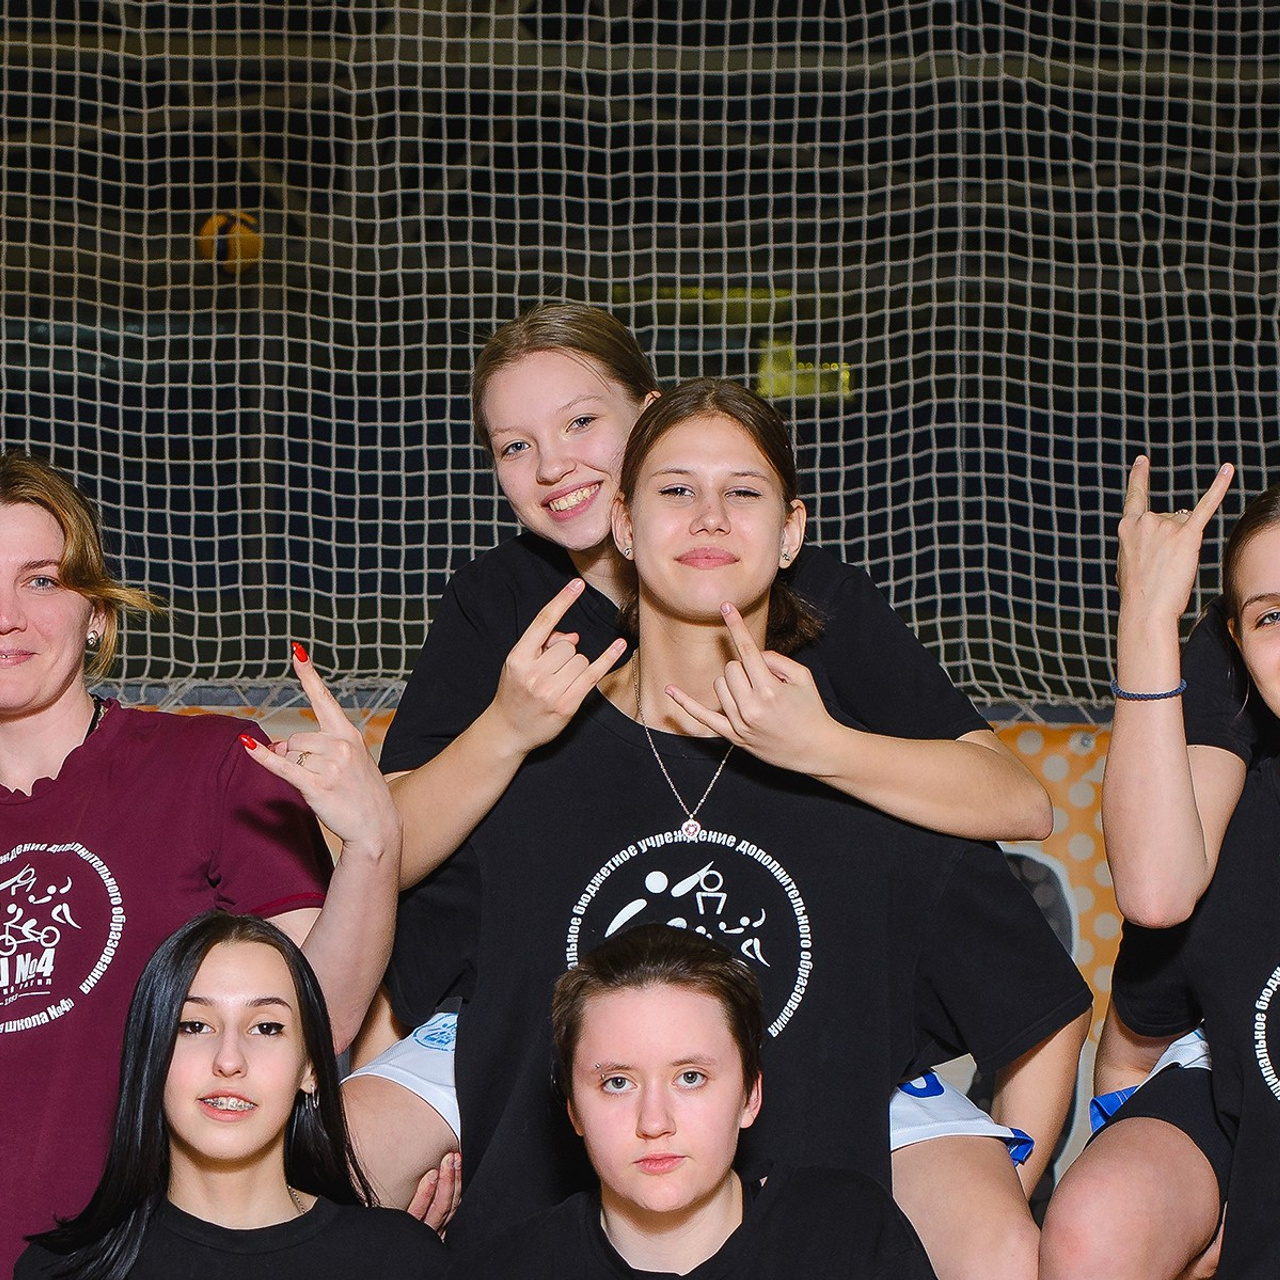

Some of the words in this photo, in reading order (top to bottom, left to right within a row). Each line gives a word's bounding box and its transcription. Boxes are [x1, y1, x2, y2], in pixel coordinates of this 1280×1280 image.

[573, 844, 638, 915] бюджетное
[736, 839, 812, 948] дополнительного
[79, 907, 126, 995] образования
[768, 950, 813, 1038] образования
[3, 1012, 49, 1033] школа
